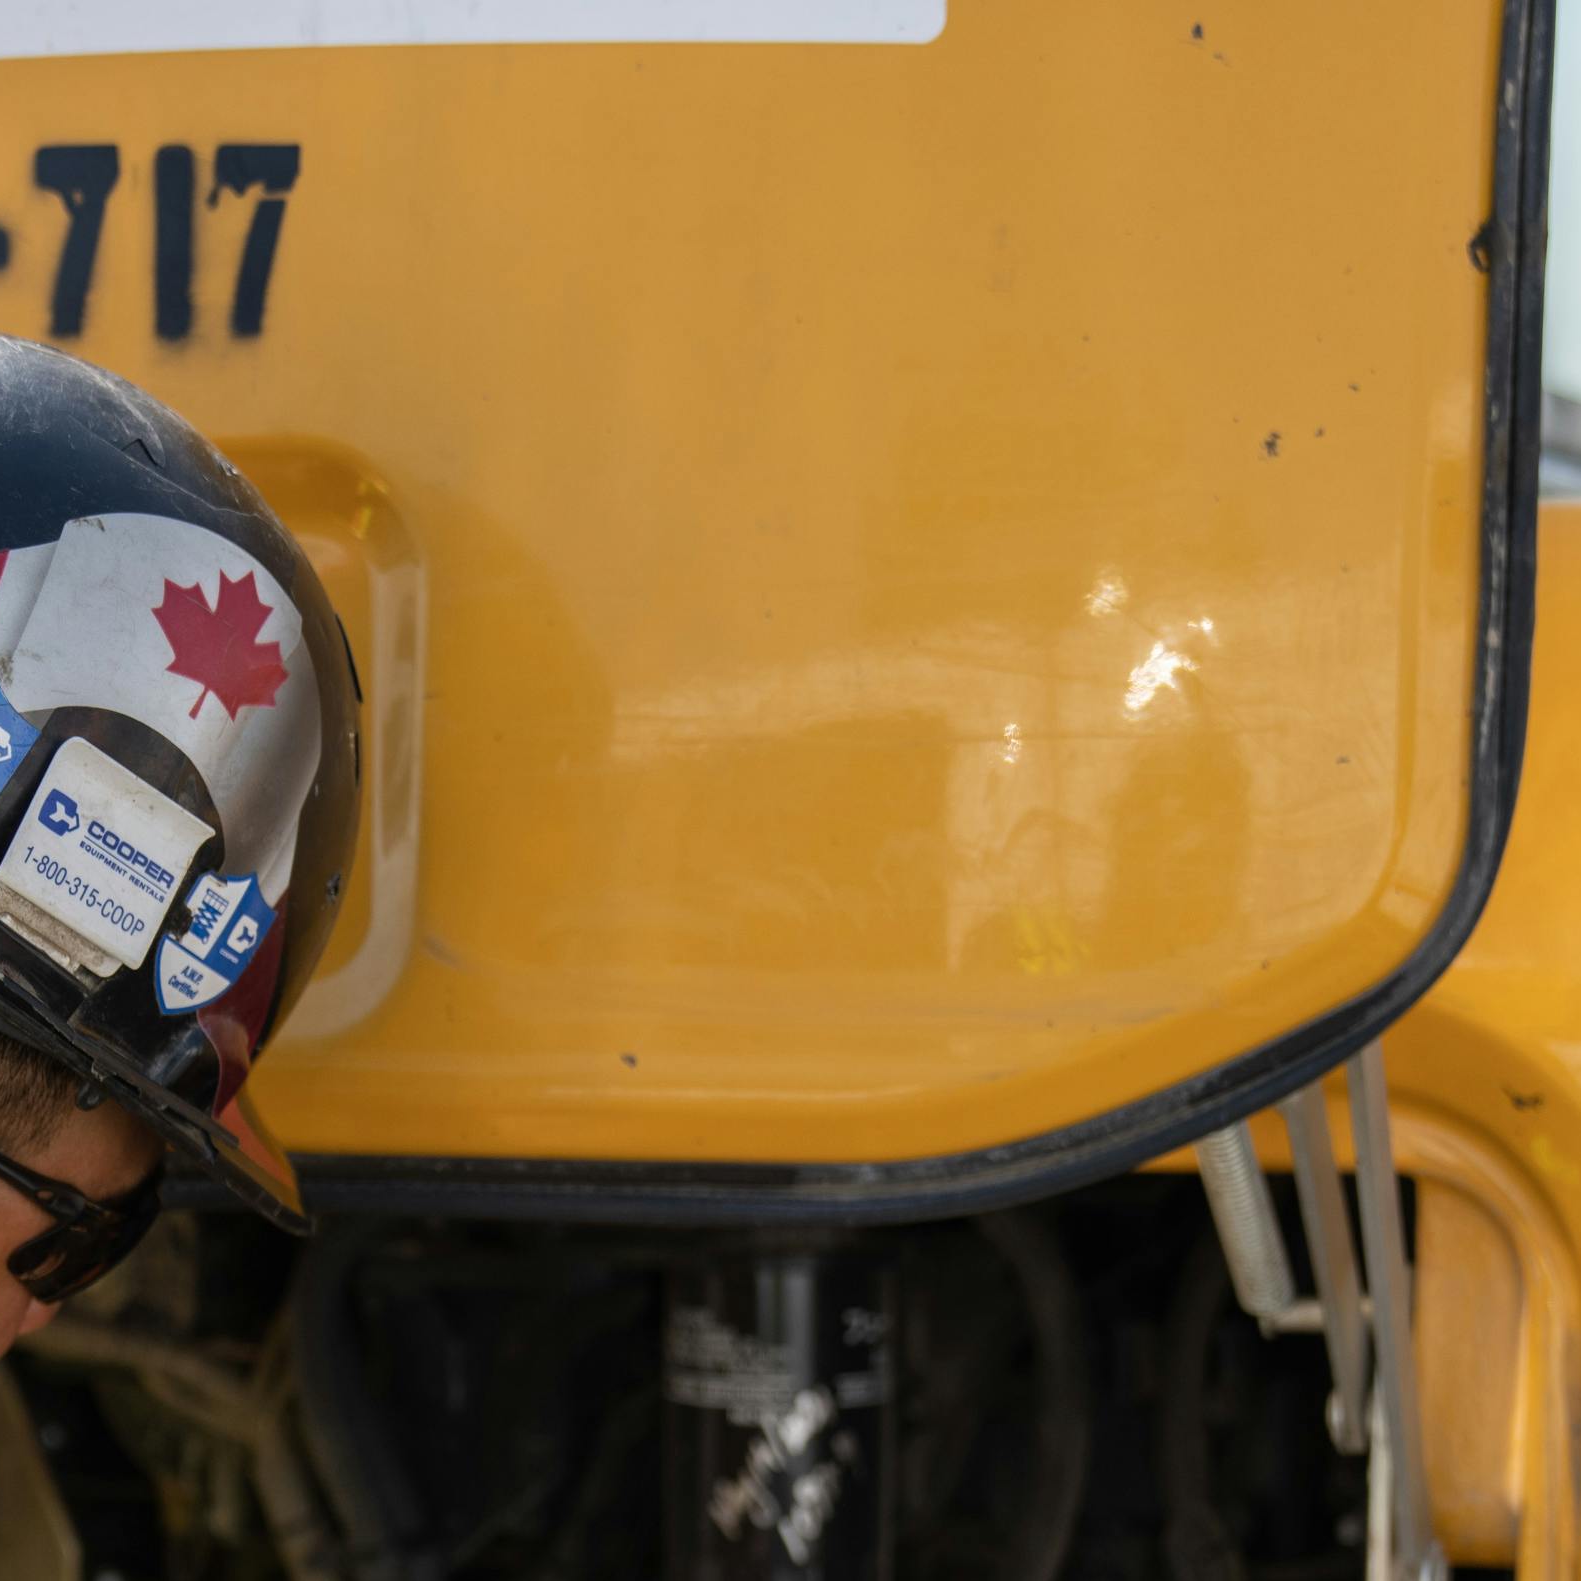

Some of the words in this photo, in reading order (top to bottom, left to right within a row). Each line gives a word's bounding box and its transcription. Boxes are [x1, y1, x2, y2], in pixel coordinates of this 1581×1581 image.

[79, 840, 127, 878] EQUIPMENT
[128, 874, 166, 903] RENTALS
[87, 820, 175, 890] COOPER
[23, 845, 146, 938] 1-800-315-COOP
[167, 975, 198, 1000] Certified
